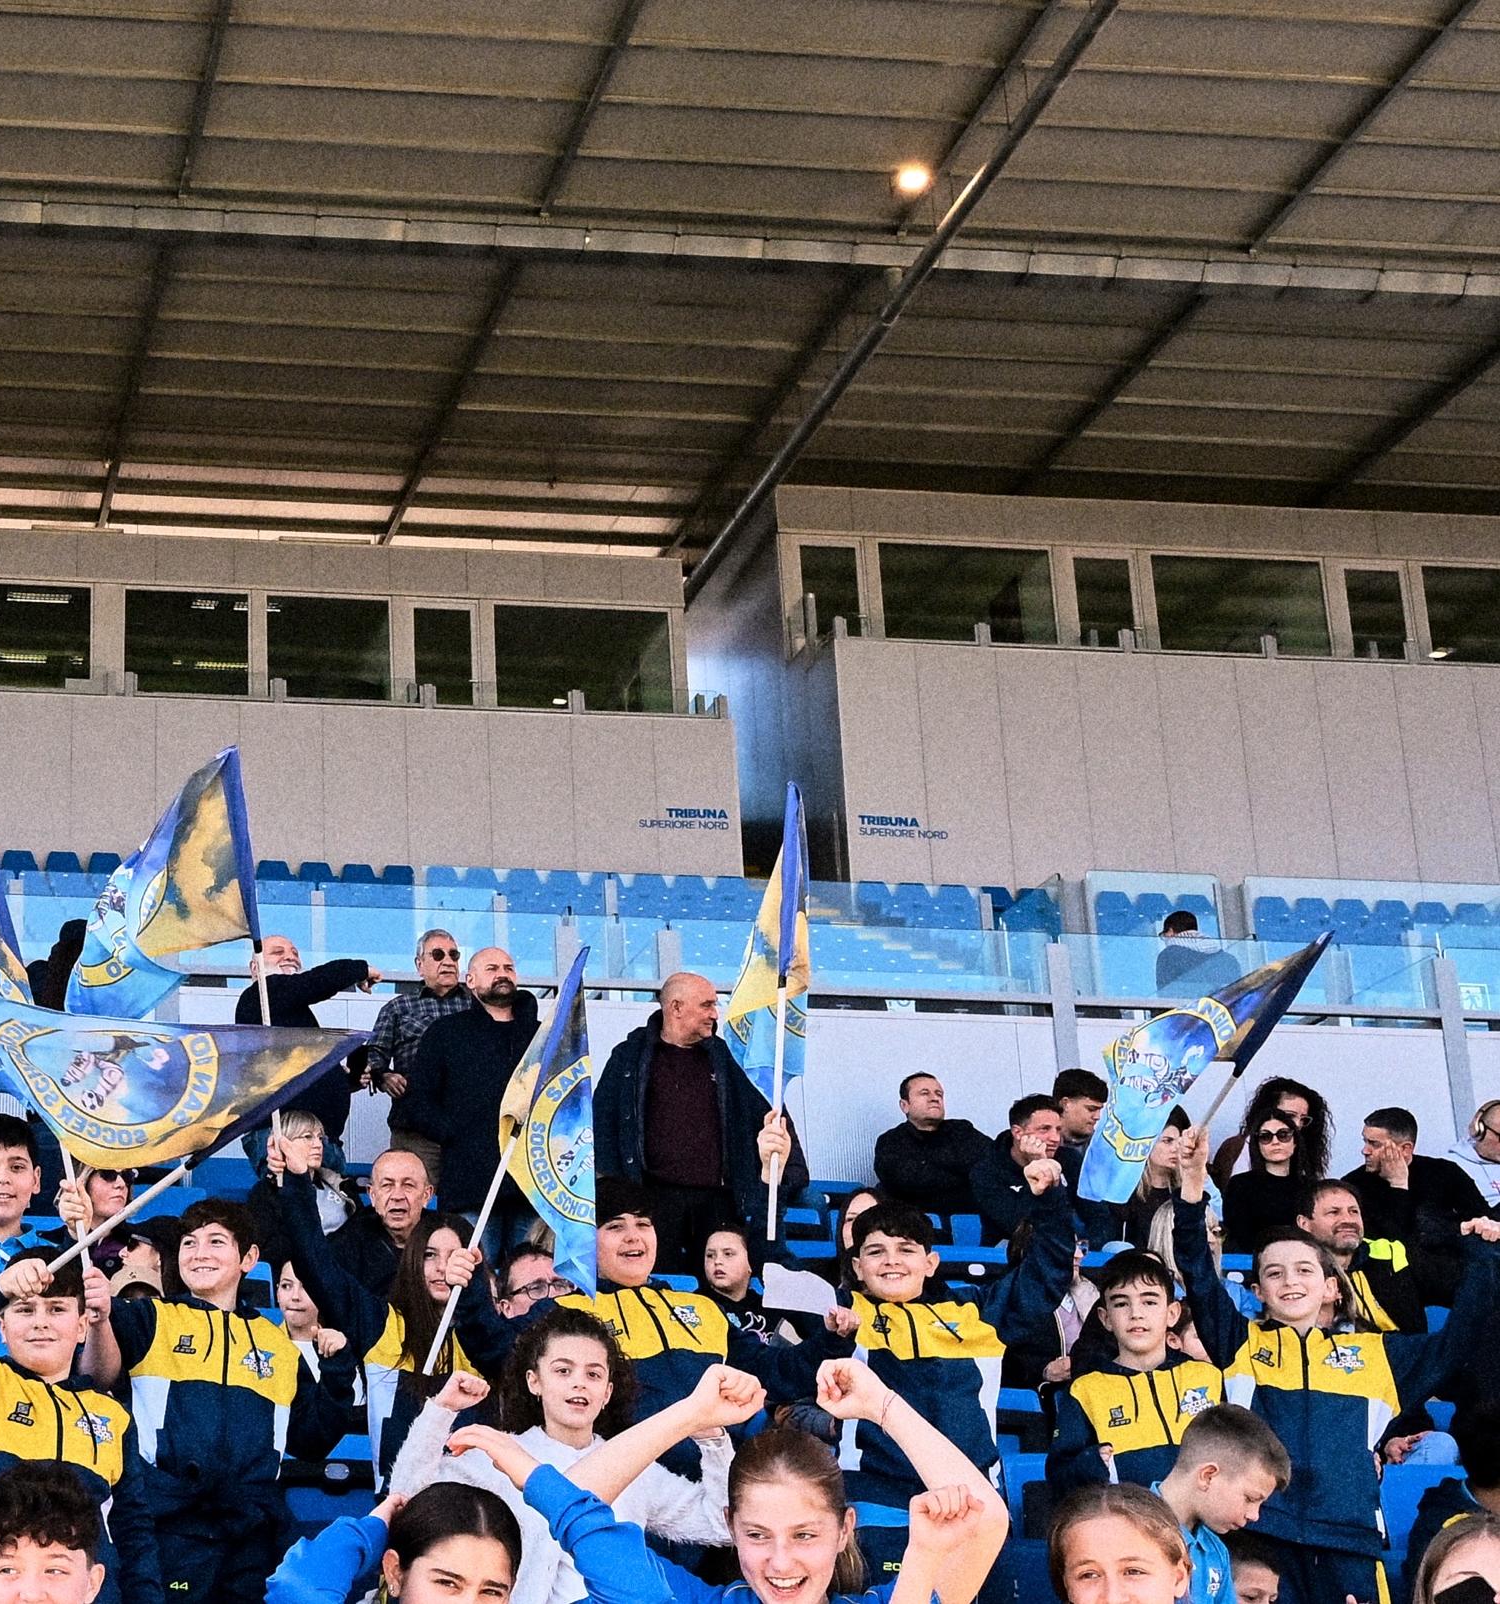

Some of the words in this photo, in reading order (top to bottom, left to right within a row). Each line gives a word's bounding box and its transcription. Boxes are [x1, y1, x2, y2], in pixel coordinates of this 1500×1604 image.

[666, 808, 728, 819] TRIBUNA
[638, 819, 696, 829] SUPERIORE
[698, 820, 729, 830] NORD
[858, 815, 919, 827] TRIBUNA
[859, 827, 916, 838] SUPERIORE
[917, 830, 948, 840] NORD
[546, 1061, 586, 1102] SAN
[530, 1121, 557, 1195] SOCCER
[170, 1581, 188, 1590] 44
